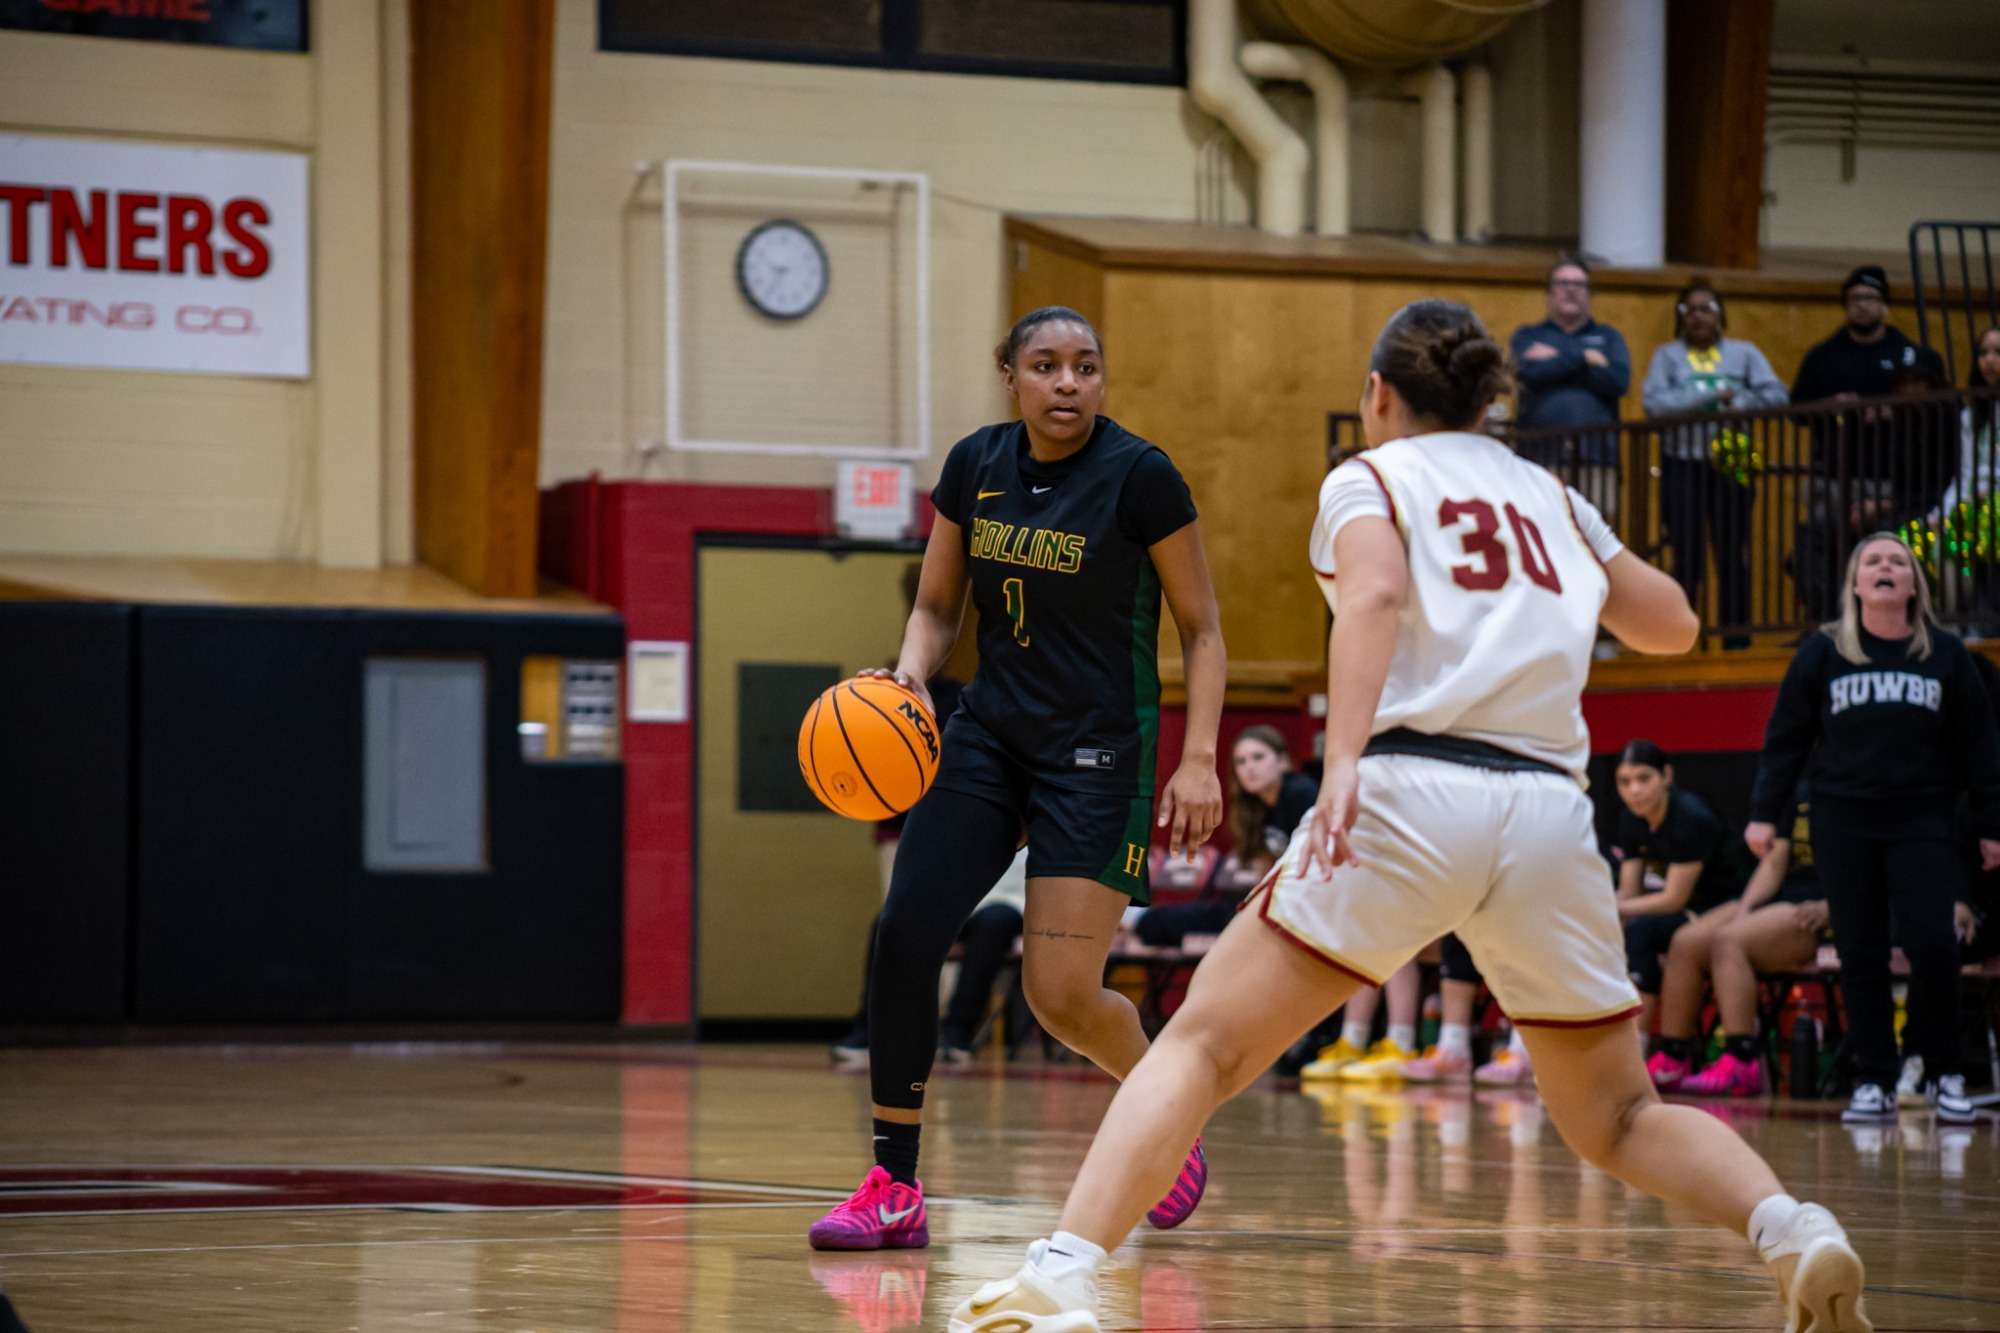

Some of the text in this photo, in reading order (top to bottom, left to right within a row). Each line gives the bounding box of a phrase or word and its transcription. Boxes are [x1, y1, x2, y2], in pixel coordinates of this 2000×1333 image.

[0, 184, 271, 280] TNERS
[0, 296, 155, 331] ATING
[970, 517, 1086, 574] HOLLINS
[1437, 495, 1563, 596] 30
[1002, 577, 1030, 648] 1
[1830, 670, 1943, 715] HUWBB
[897, 700, 939, 766] NCAA
[1101, 754, 1111, 764] M
[1122, 842, 1146, 878] H
